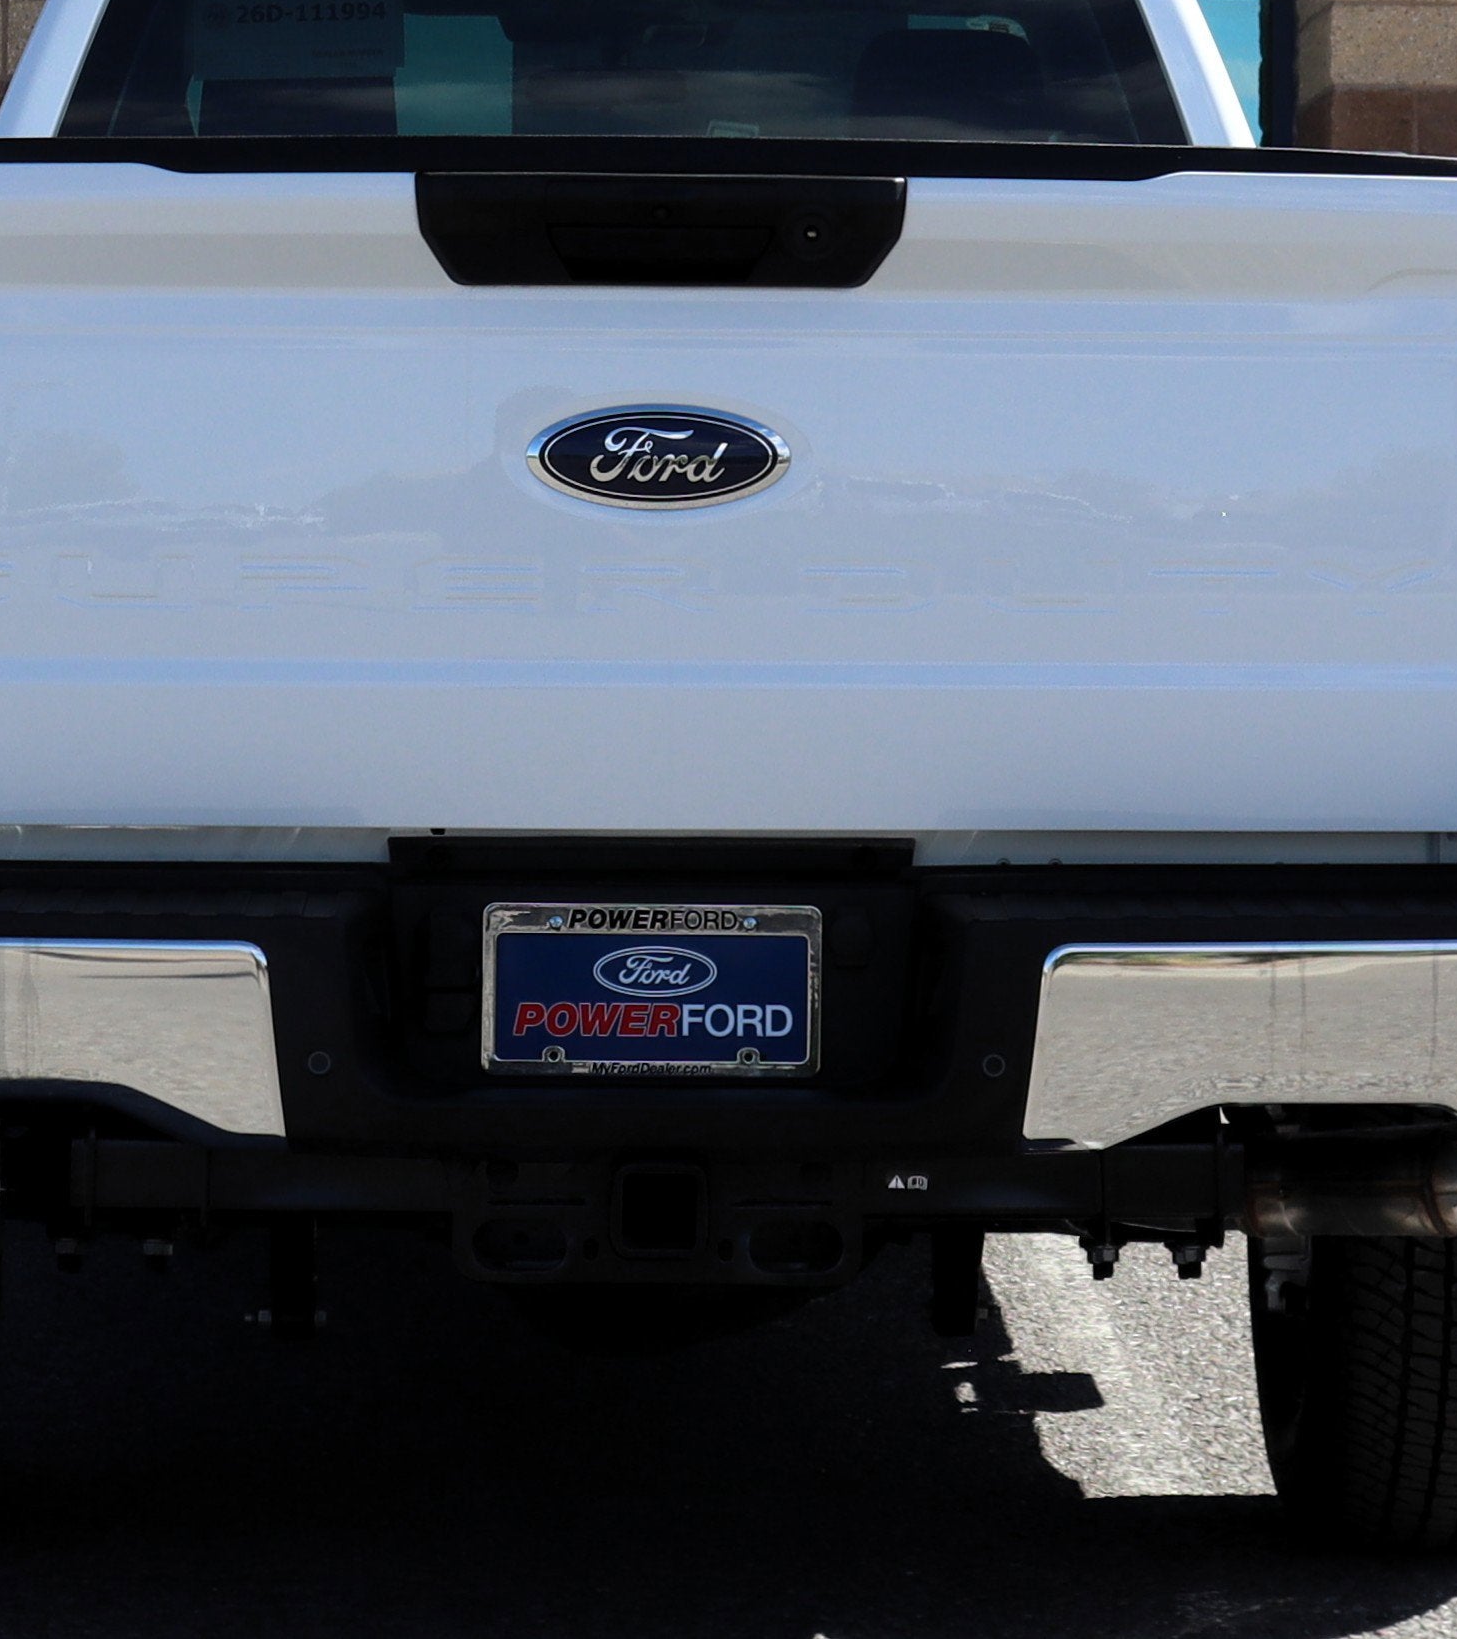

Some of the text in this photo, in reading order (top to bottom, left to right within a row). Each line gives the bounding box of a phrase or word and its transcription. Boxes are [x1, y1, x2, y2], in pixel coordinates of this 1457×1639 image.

[236, 1, 387, 24] 26D-111994
[589, 426, 729, 483] Ford
[799, 556, 1441, 617] DUTY
[568, 908, 738, 931] POWERFORD
[618, 955, 691, 986] Ford
[513, 1002, 793, 1038] POWERFORD
[591, 1061, 712, 1075] MyFordDealer.com
